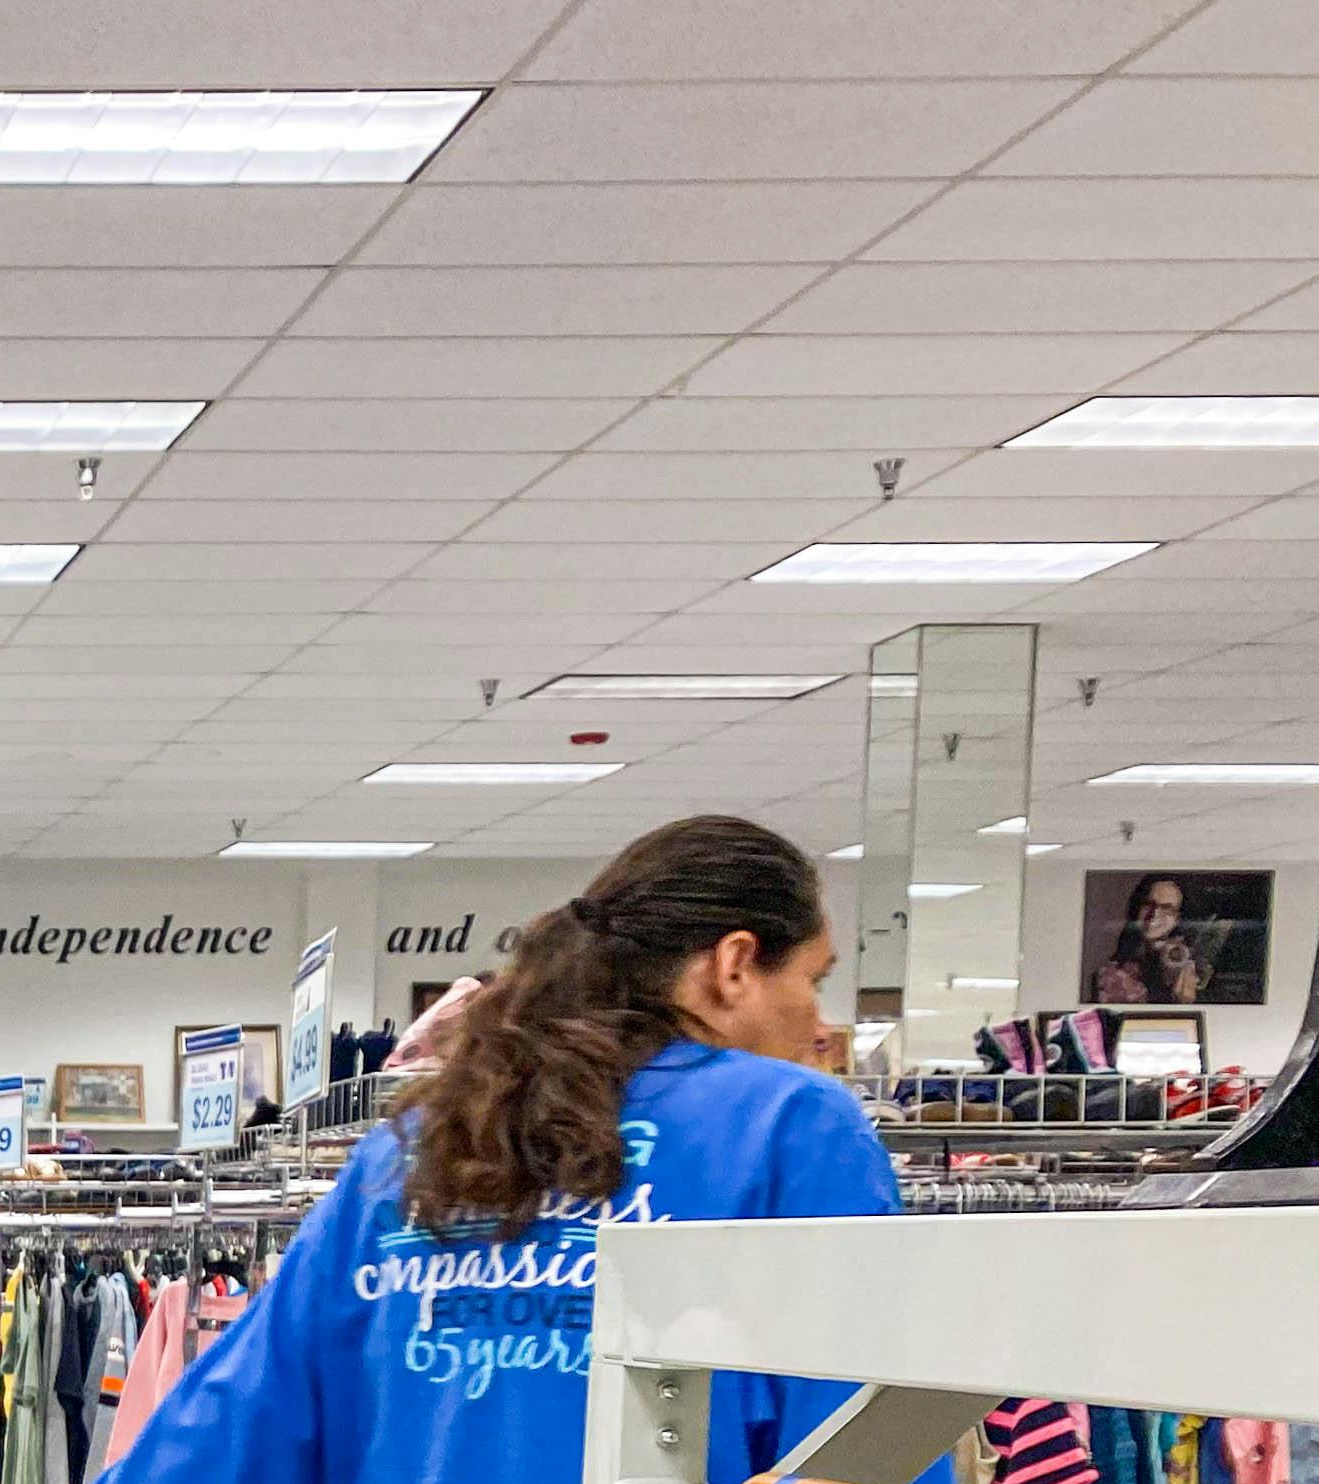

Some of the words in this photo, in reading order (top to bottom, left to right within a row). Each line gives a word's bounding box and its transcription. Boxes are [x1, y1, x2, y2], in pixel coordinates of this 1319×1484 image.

[386, 913, 476, 953] and
[192, 1093, 233, 1133] $2.29
[505, 1291, 596, 1328] OVE
[405, 1322, 464, 1383] 65
